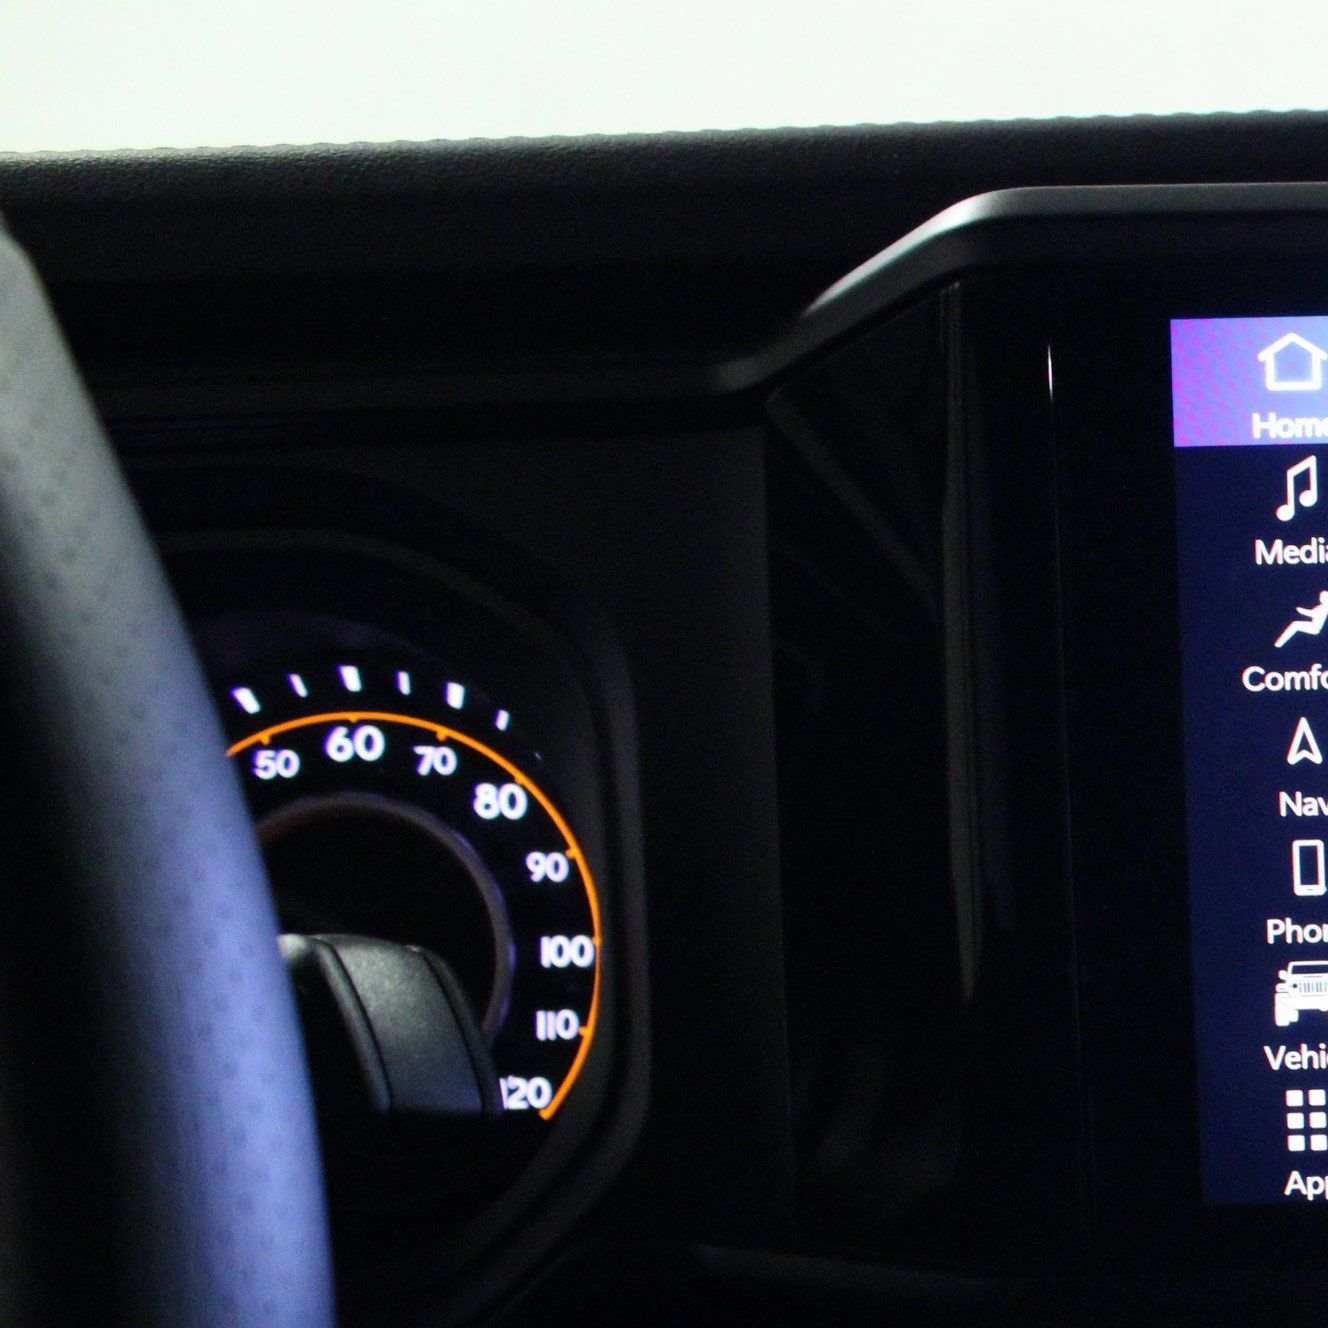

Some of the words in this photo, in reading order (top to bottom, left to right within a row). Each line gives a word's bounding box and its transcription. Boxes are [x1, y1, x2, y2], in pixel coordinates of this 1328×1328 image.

[325, 725, 385, 762] 60
[252, 749, 300, 780] 50
[413, 745, 458, 776] 70
[473, 783, 527, 820] 80
[526, 852, 569, 882] 90
[541, 936, 594, 968] 100
[536, 1010, 580, 1041] 110
